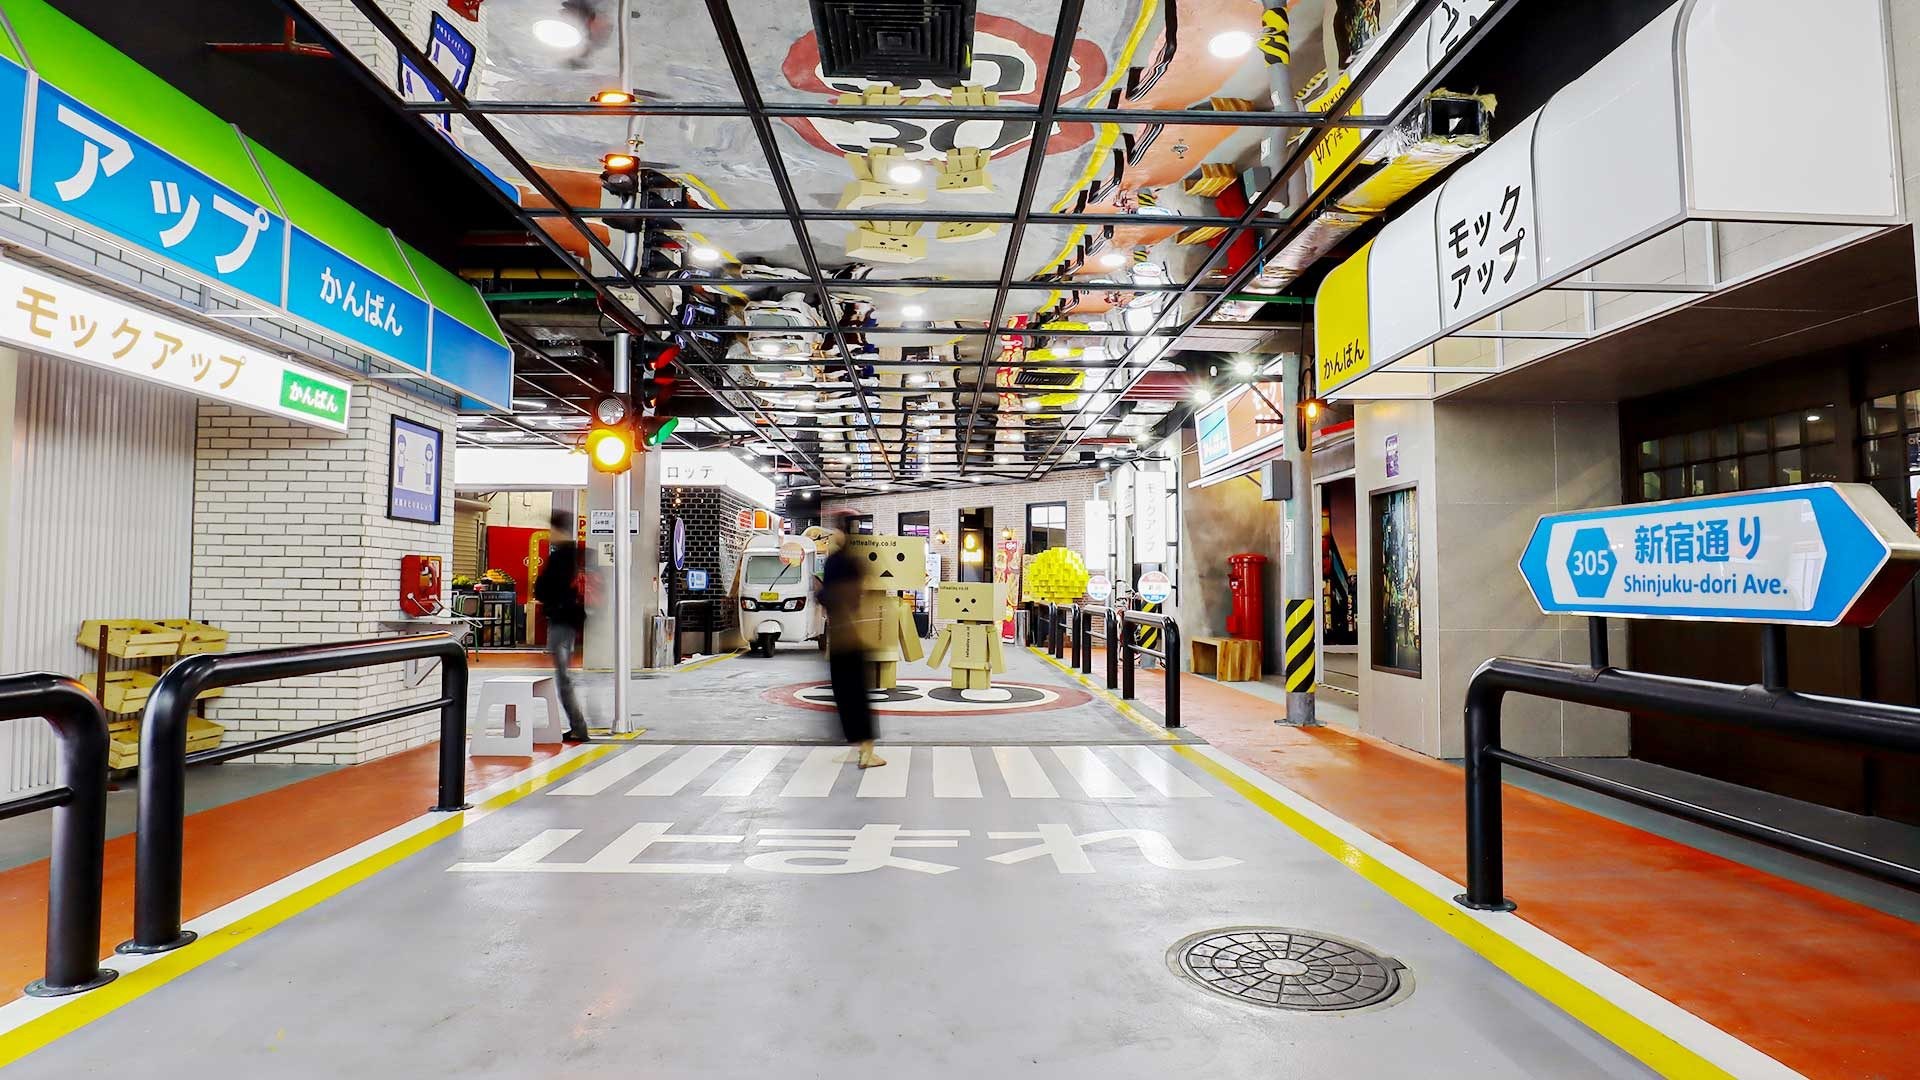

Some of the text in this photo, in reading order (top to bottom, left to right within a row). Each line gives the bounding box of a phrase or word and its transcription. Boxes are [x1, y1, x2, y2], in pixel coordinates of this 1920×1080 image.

[54, 103, 270, 274] アップ
[1447, 184, 1521, 259] モック
[1451, 227, 1527, 309] アップ
[320, 266, 403, 337] かんばん
[16, 286, 246, 390] モックアップ
[1323, 338, 1365, 380] かんばん
[289, 379, 339, 414] かんばん
[667, 465, 713, 479] ロッテ
[1573, 550, 1609, 576] 305
[1634, 515, 1762, 565] 新宿通り
[1623, 573, 1788, 597] Shinjuku-dori Ave.
[446, 822, 1244, 875] 止まれ
